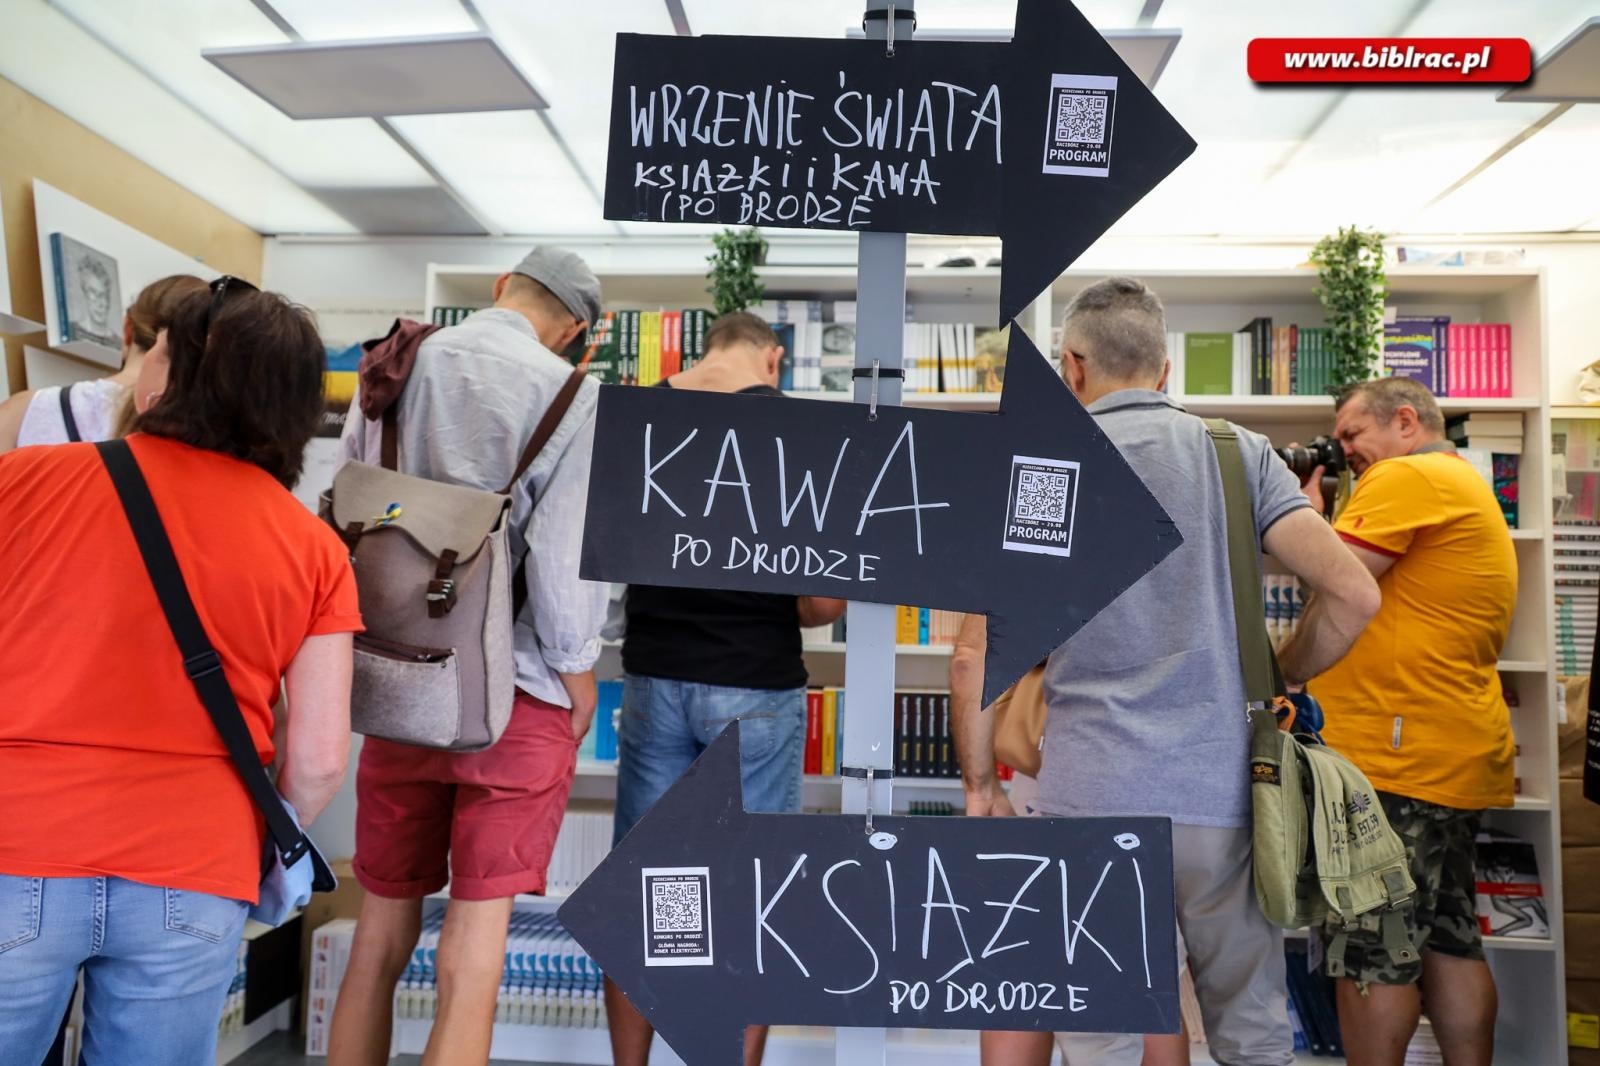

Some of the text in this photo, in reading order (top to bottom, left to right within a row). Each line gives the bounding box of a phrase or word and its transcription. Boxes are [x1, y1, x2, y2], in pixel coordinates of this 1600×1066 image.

[630, 71, 1002, 164] WRZENIE ŚWIATA
[1049, 148, 1107, 163] PROGRAM
[832, 152, 941, 204] KAWA
[641, 421, 950, 555] KAWA
[671, 533, 712, 569] PO
[1008, 525, 1068, 543] PROGRAM
[889, 980, 1089, 1013] PO DRODZE
